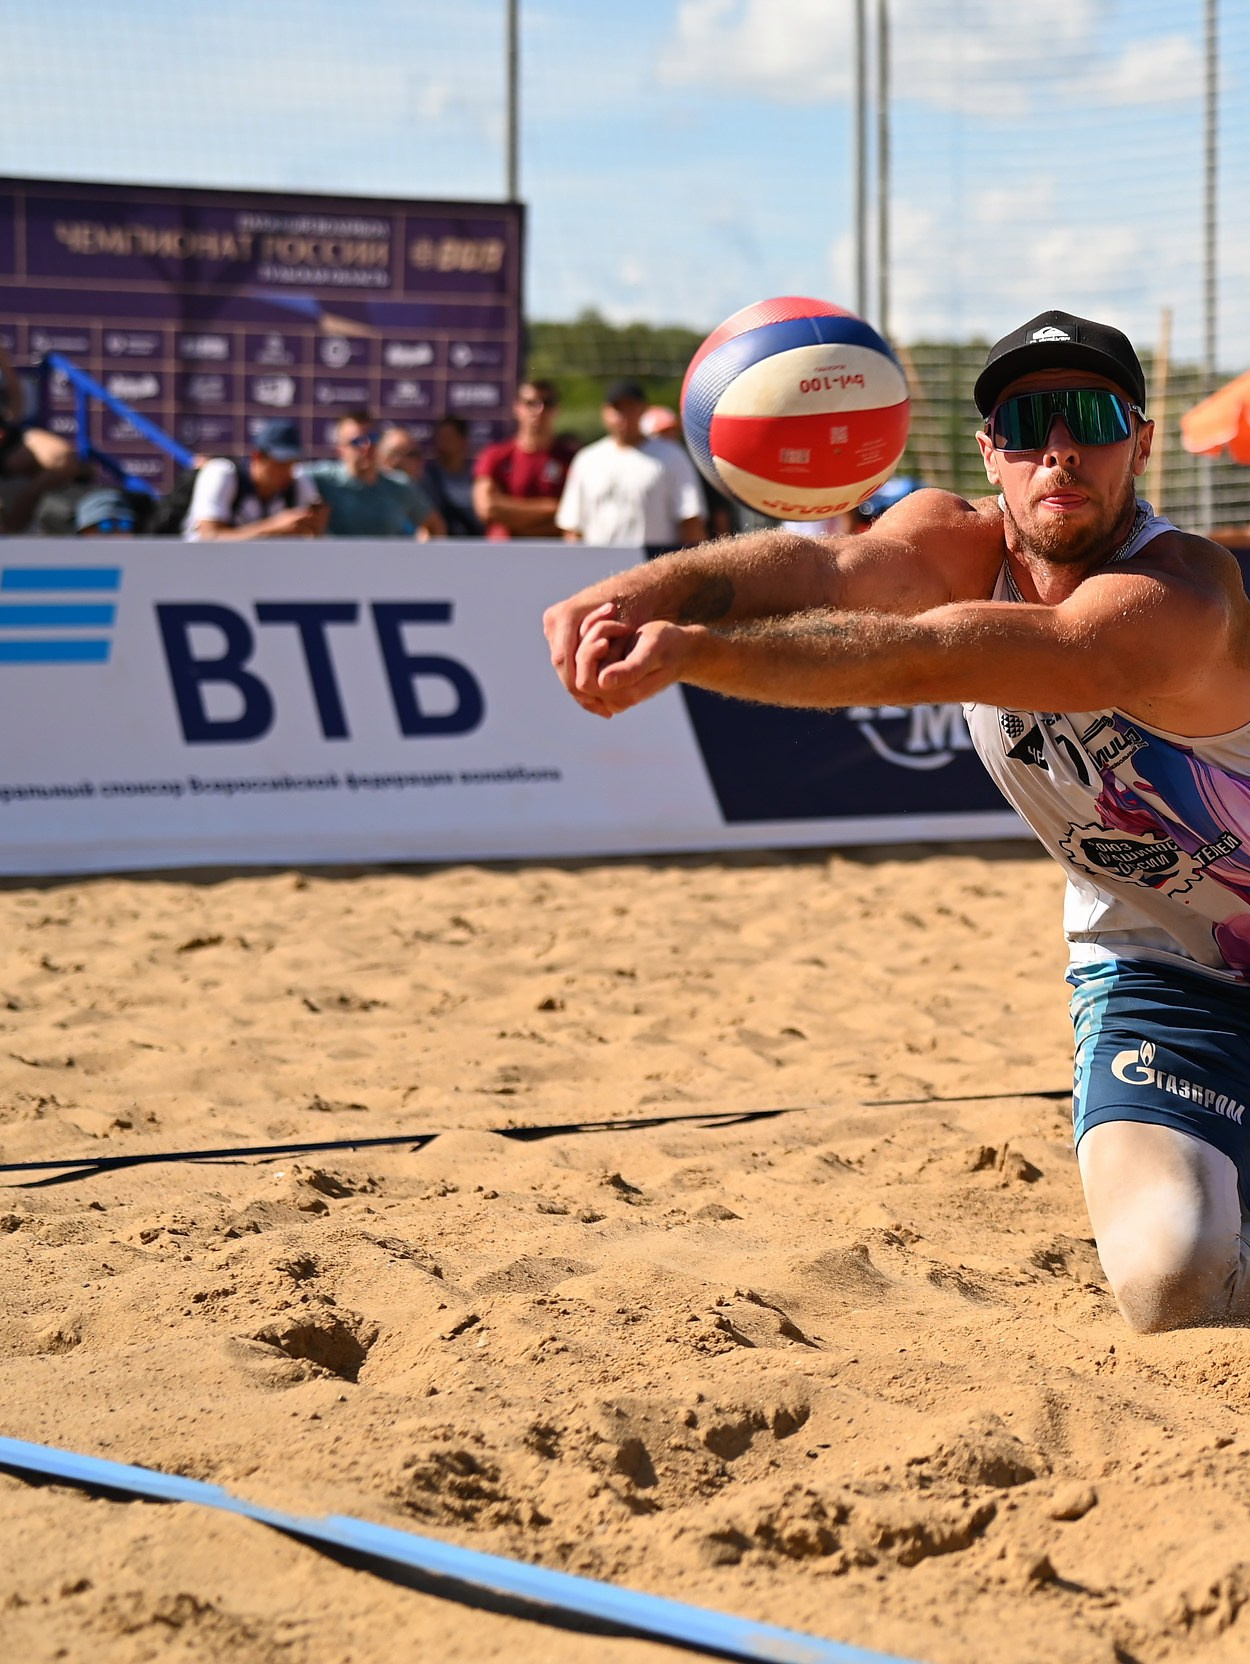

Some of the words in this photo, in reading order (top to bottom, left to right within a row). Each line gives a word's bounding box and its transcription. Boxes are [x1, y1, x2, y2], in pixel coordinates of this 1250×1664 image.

[799, 374, 865, 394] bvl-100
[155, 600, 486, 746] ВТБ
[1156, 1070, 1246, 1126] ГАЗПРОМ
